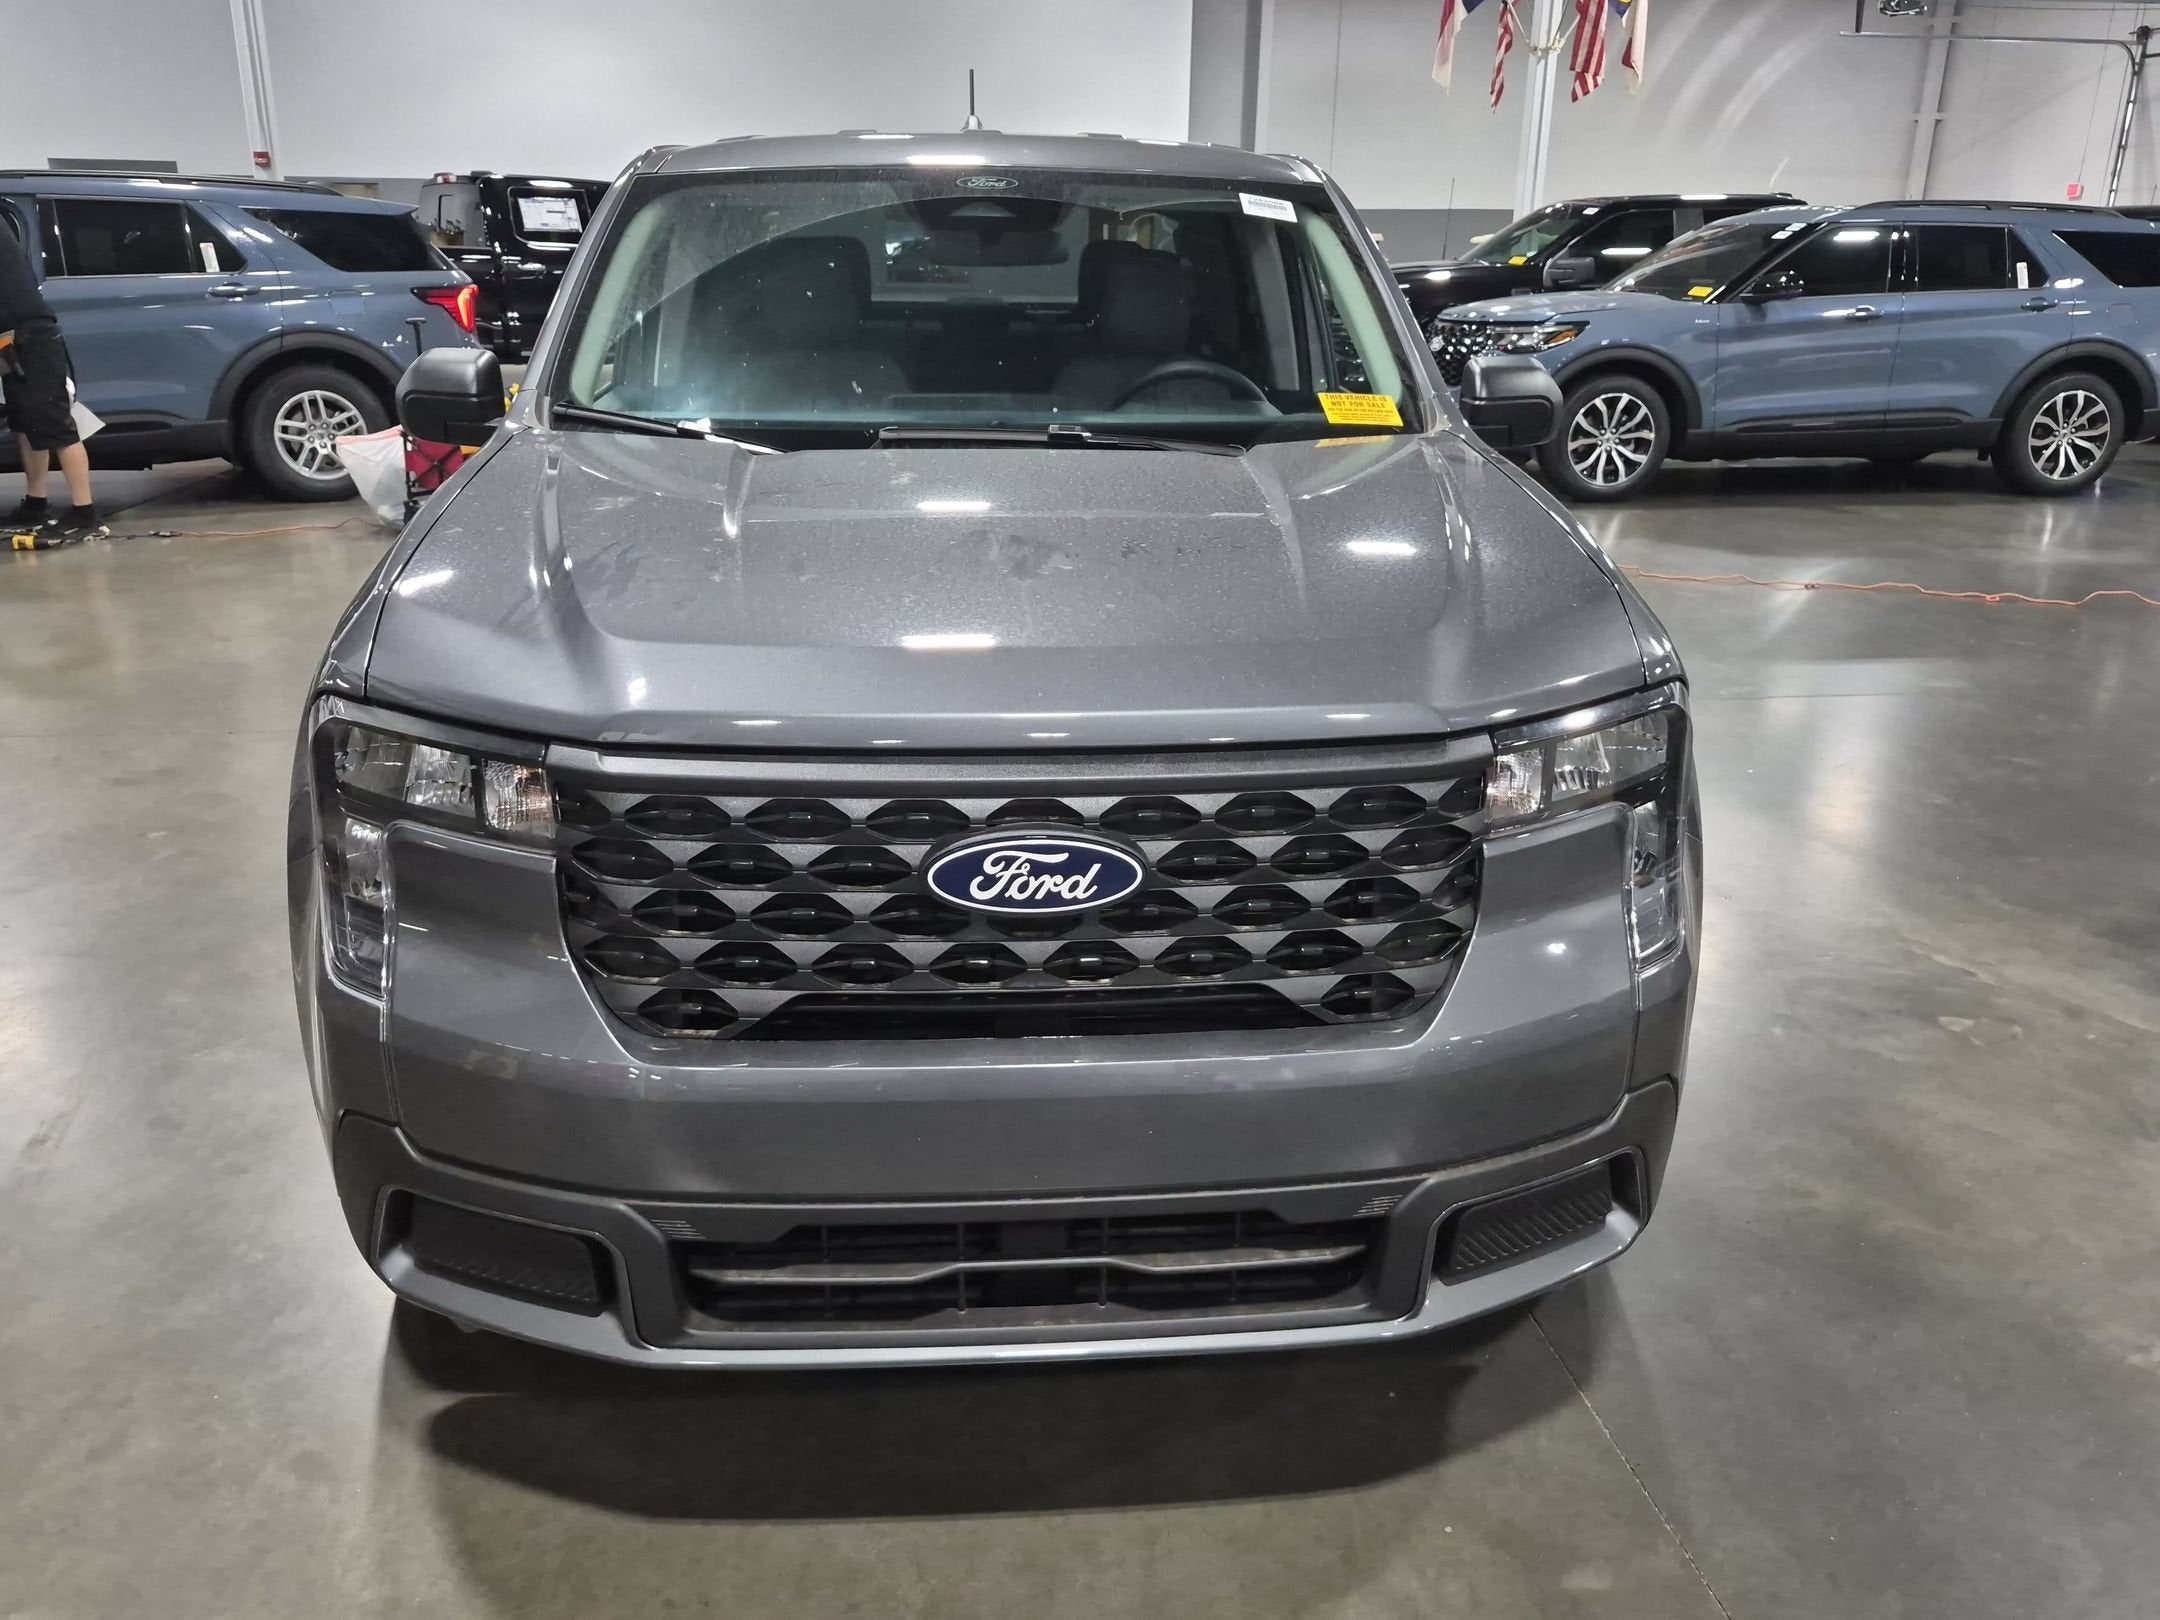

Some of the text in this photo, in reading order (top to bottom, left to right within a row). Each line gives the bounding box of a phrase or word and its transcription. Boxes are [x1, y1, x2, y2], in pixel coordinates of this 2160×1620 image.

[967, 178, 1008, 187] Ford
[1344, 394, 1377, 402] VEHICLE
[969, 850, 1102, 900] Ford
